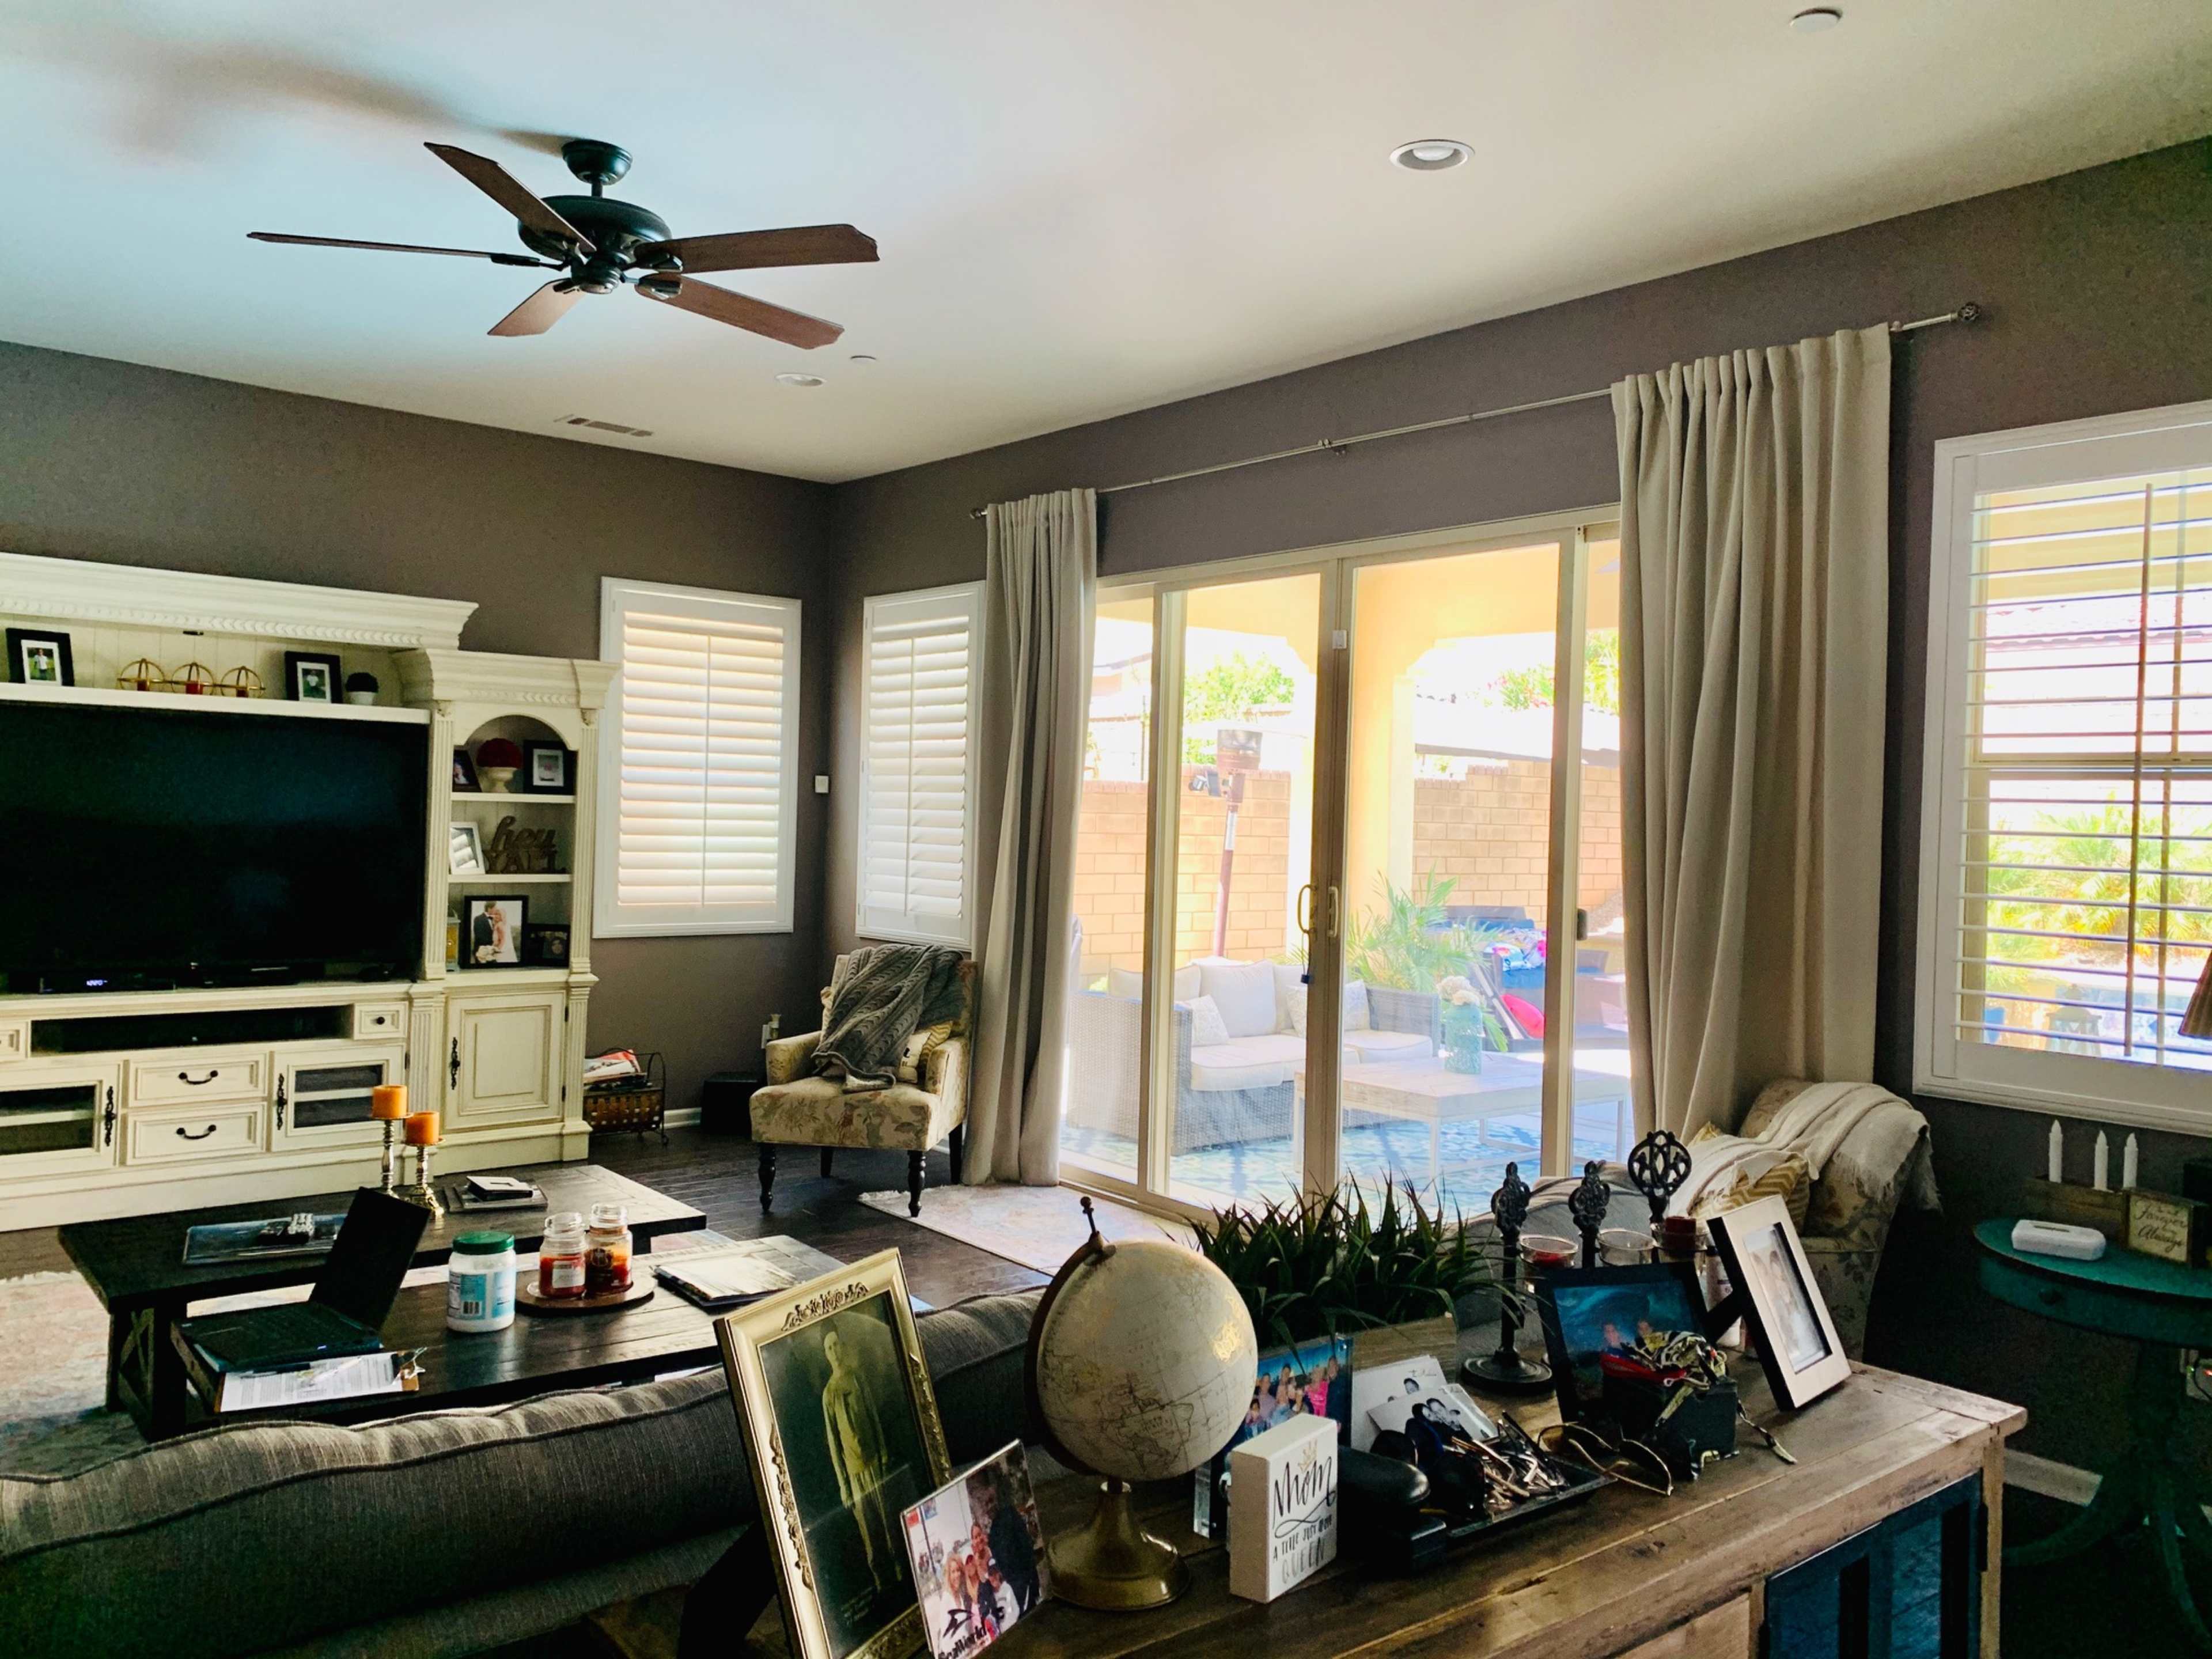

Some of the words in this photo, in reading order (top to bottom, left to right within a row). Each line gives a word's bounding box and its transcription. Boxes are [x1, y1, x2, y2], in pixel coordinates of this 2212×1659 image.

[1272, 1546, 1278, 1562] A
[1302, 1524, 1317, 1542] JUST
[1282, 1536, 1326, 1584] QUEEN
